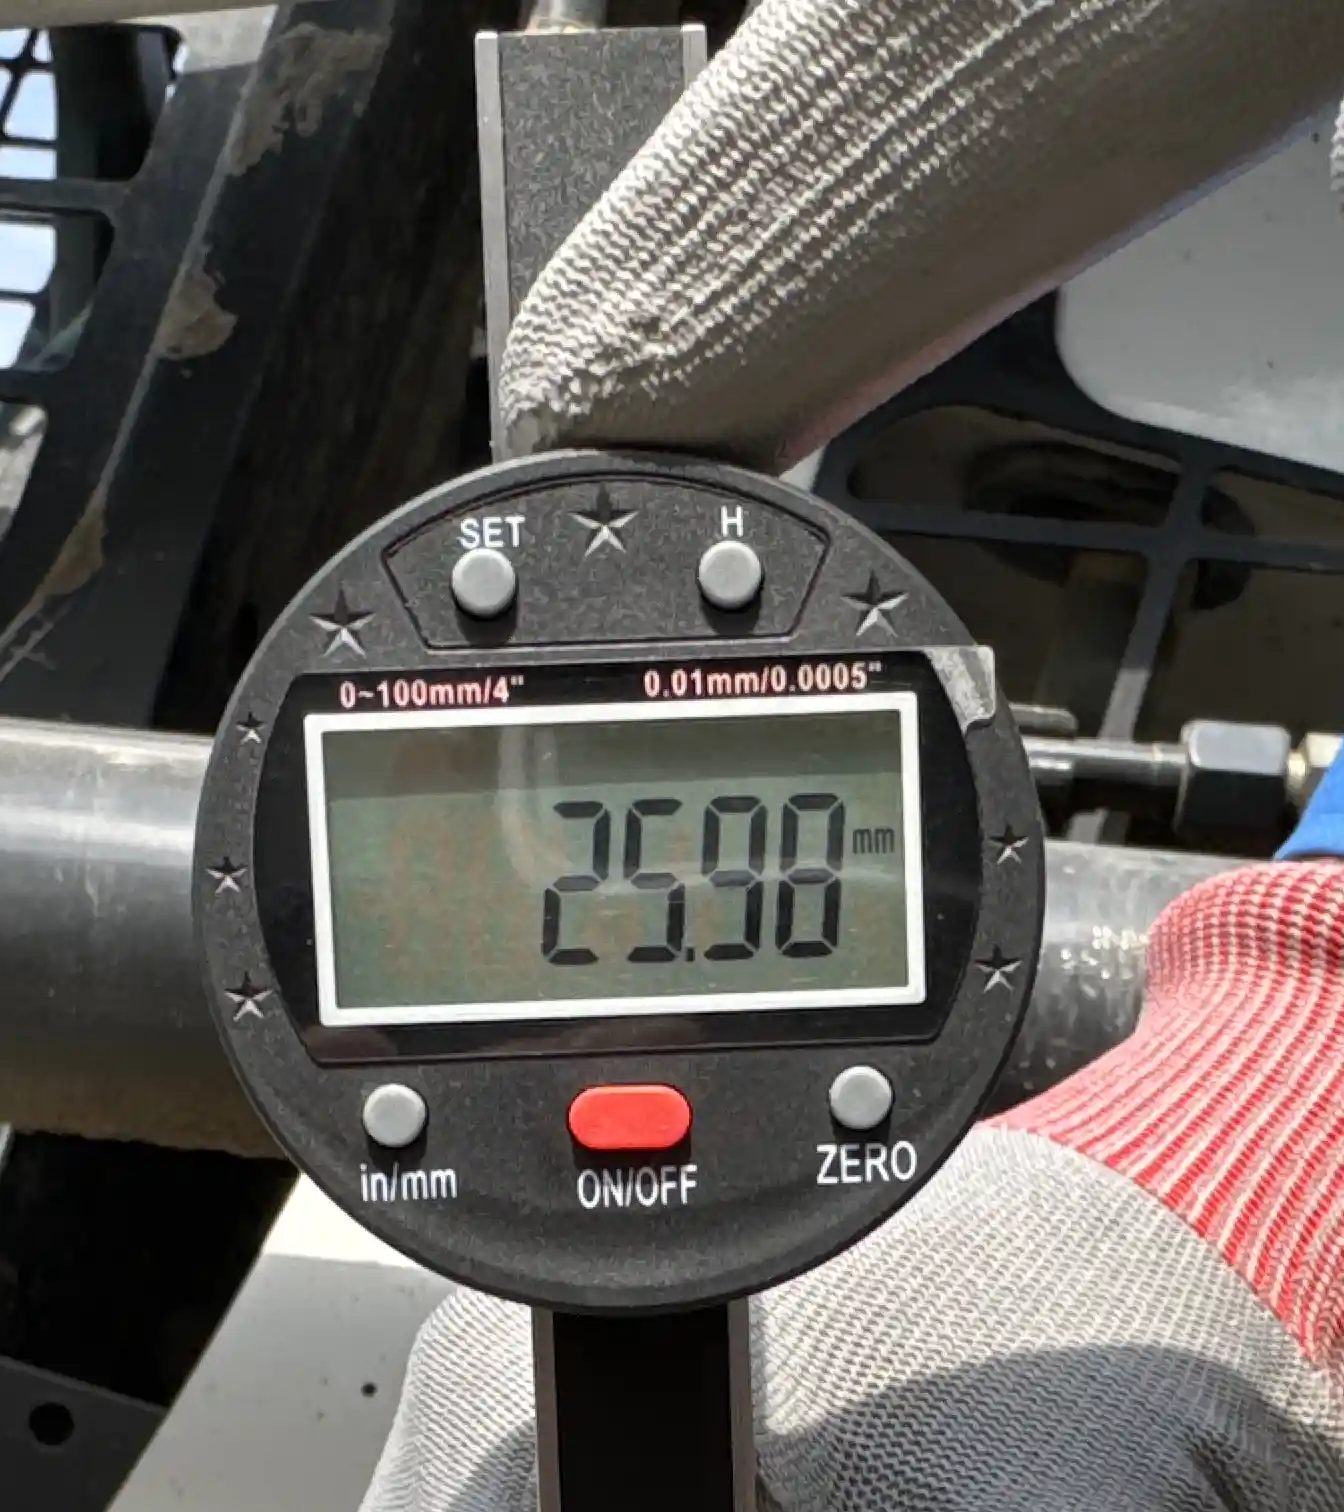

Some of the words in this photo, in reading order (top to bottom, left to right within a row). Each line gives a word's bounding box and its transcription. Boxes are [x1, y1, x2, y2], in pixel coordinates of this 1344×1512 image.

[459, 516, 526, 549] SET
[721, 506, 744, 538] H
[339, 675, 525, 709] 0~100mm/4"
[644, 662, 881, 697] 0.01mm/0.0005"
[542, 793, 844, 966] 25.98
[852, 826, 895, 853] mm
[816, 1141, 917, 1184] ZERO
[360, 1165, 457, 1203] in/mm
[577, 1165, 697, 1209] ON/OFF
